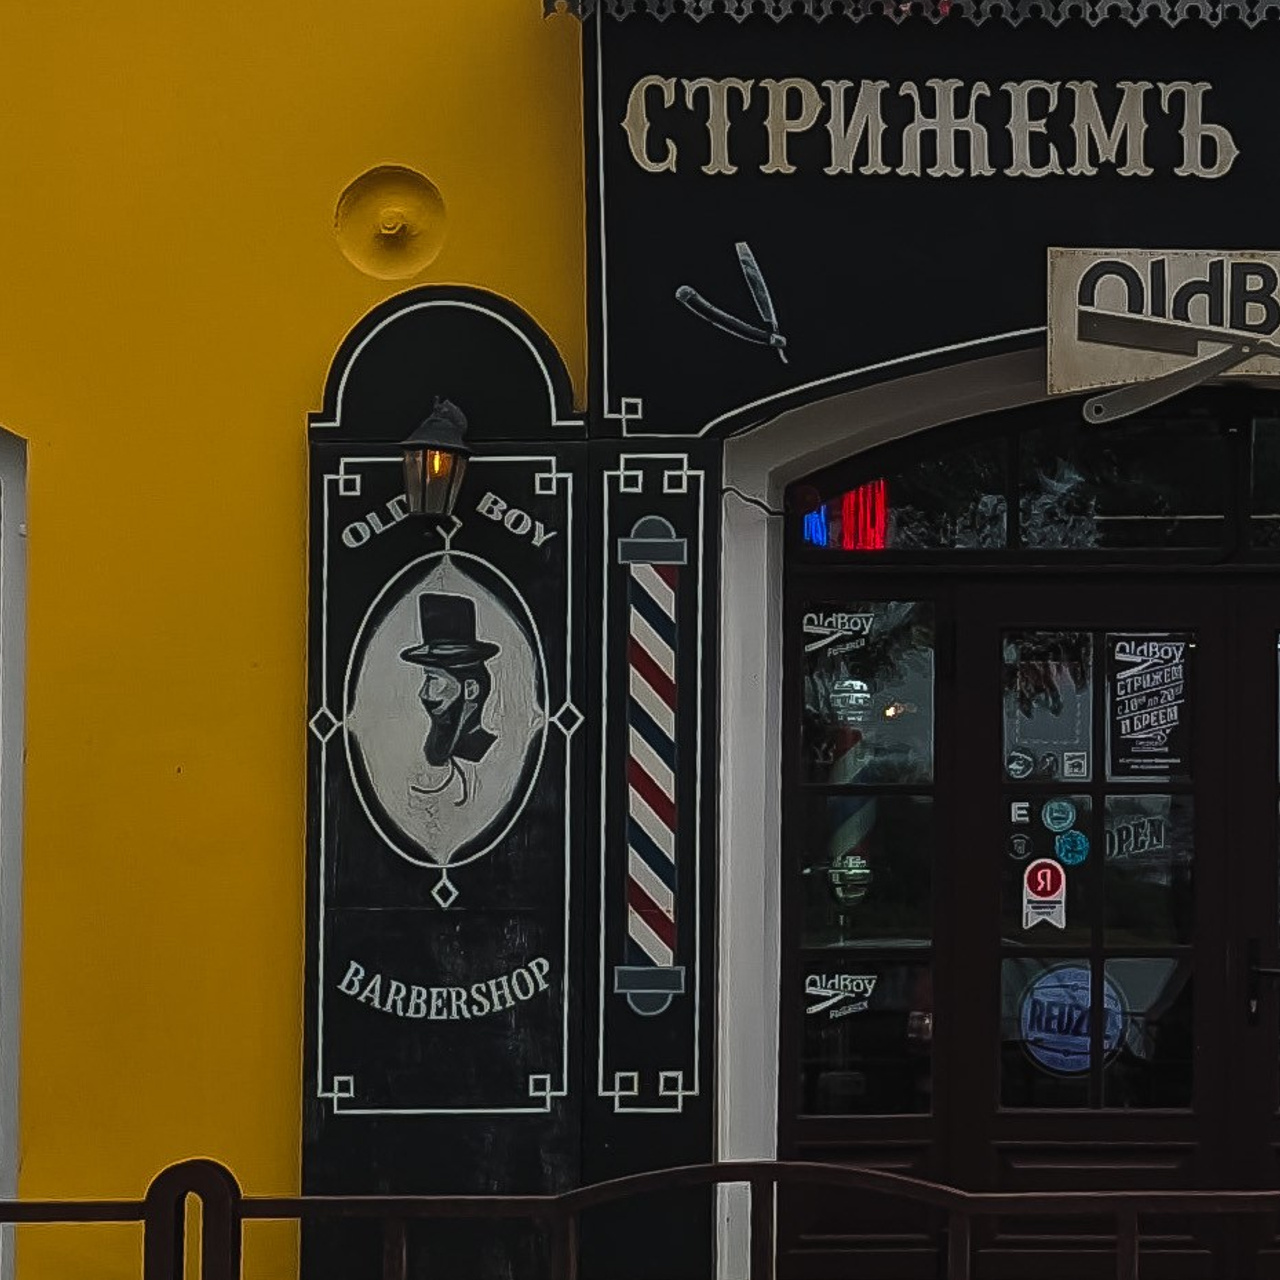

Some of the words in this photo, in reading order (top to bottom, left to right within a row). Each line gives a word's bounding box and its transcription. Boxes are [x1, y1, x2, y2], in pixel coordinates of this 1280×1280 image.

[621, 74, 1240, 178] СТРИЖЕМЪ
[475, 491, 558, 548] BOY
[803, 613, 875, 636] OldBoy
[1115, 641, 1186, 664] OldBoy
[1037, 869, 1051, 891] Я
[337, 956, 551, 1020] BARBERSHOP
[805, 973, 878, 997] OldBoy
